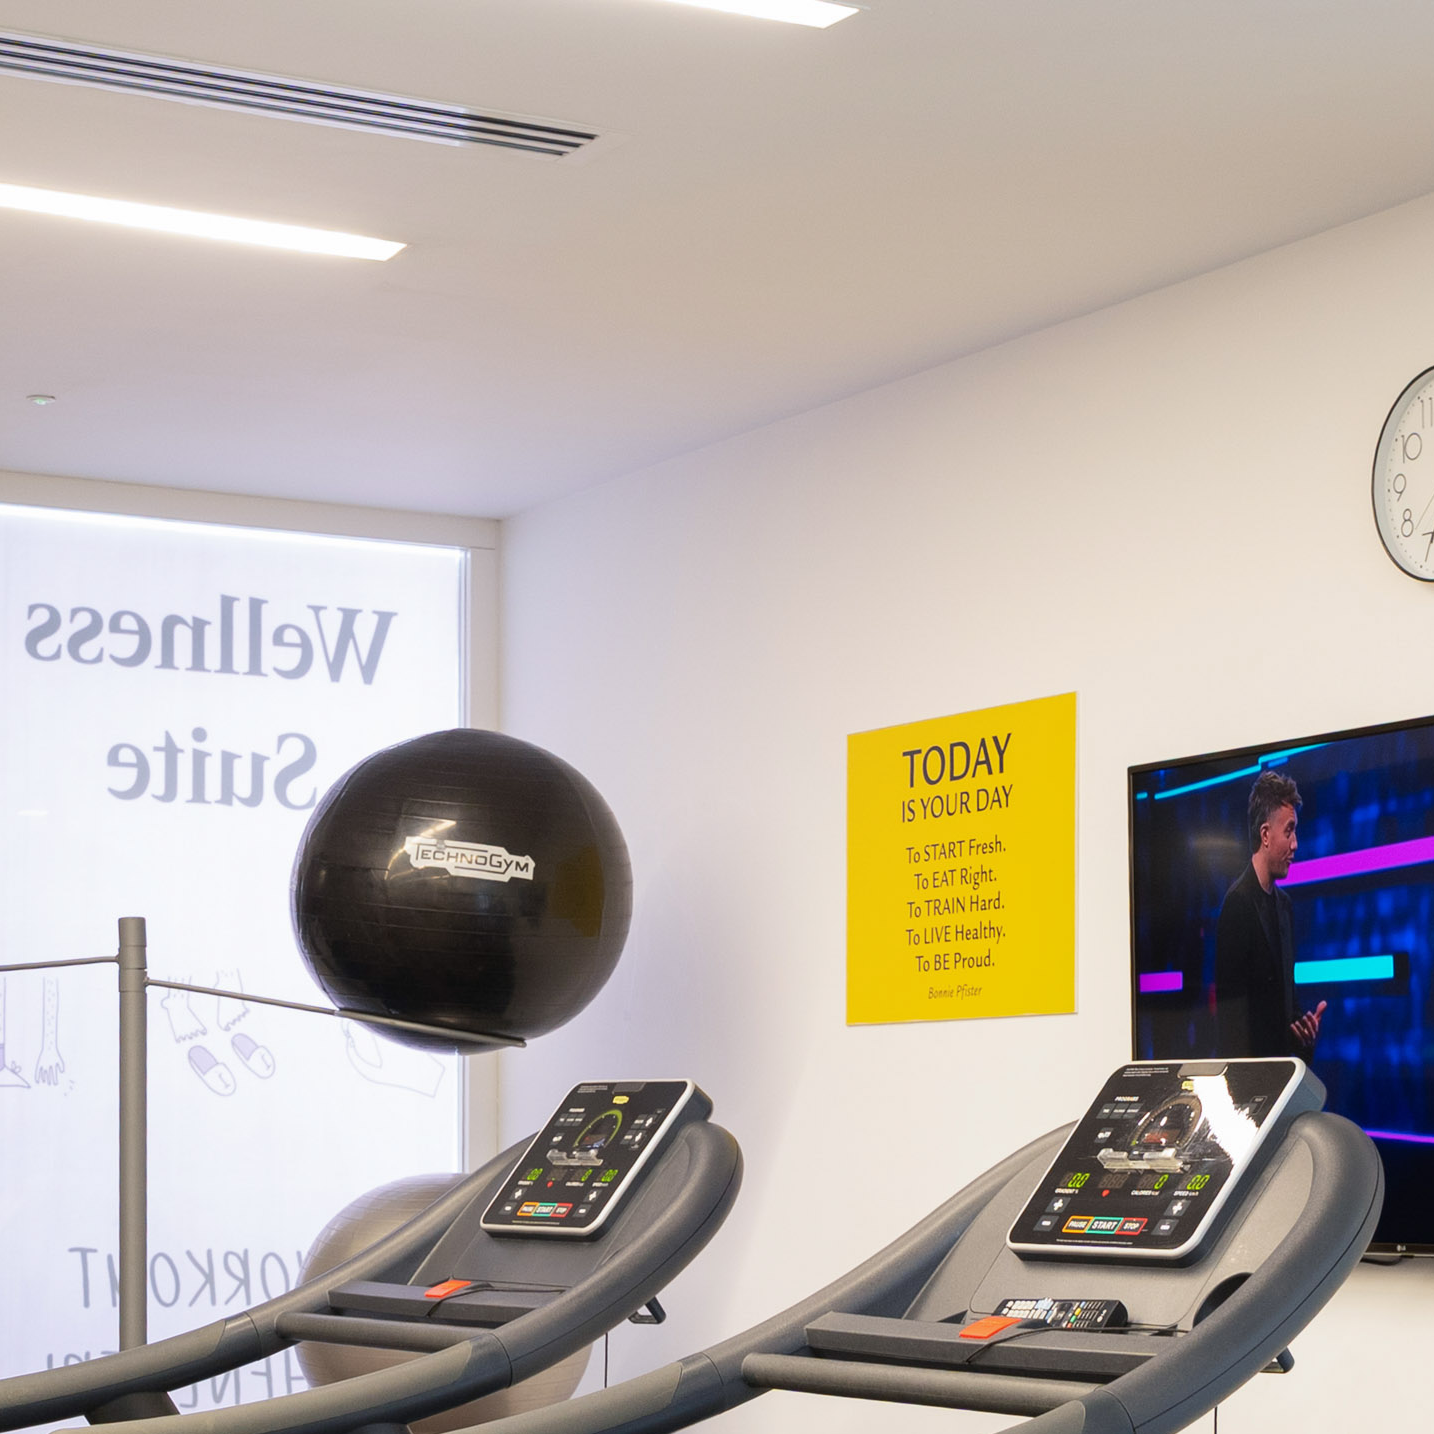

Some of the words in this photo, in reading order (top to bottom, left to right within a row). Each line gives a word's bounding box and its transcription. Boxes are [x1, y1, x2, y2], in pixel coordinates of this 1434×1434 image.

[1420, 396, 1433, 429] 11
[1401, 432, 1422, 464] 10
[1393, 473, 1407, 502] 9
[1400, 508, 1414, 538] 8
[1422, 531, 1434, 562] 7
[902, 732, 1012, 788] TODAY
[902, 799, 916, 823] IS
[920, 791, 972, 820] YOUR
[976, 784, 1013, 812] DAY
[906, 847, 921, 864] To
[924, 840, 965, 862] START
[969, 834, 1006, 856] Fresh.
[914, 873, 929, 890] To
[933, 869, 957, 888] EAT
[960, 864, 997, 890] Right.
[907, 901, 922, 918] To
[924, 896, 966, 916] TRAIN
[970, 891, 1005, 912] Hard.
[906, 929, 920, 946] To
[924, 925, 952, 945] LIVE
[955, 920, 1006, 944] Healthy.
[915, 955, 930, 972] To
[934, 953, 950, 971] BE
[954, 948, 995, 969] Proud.
[928, 987, 954, 999] Bonnie
[956, 984, 983, 1000] Pfister
[1068, 1220, 1088, 1229] PAUSE
[1091, 1220, 1118, 1230] START
[1123, 1222, 1140, 1230] STOP
